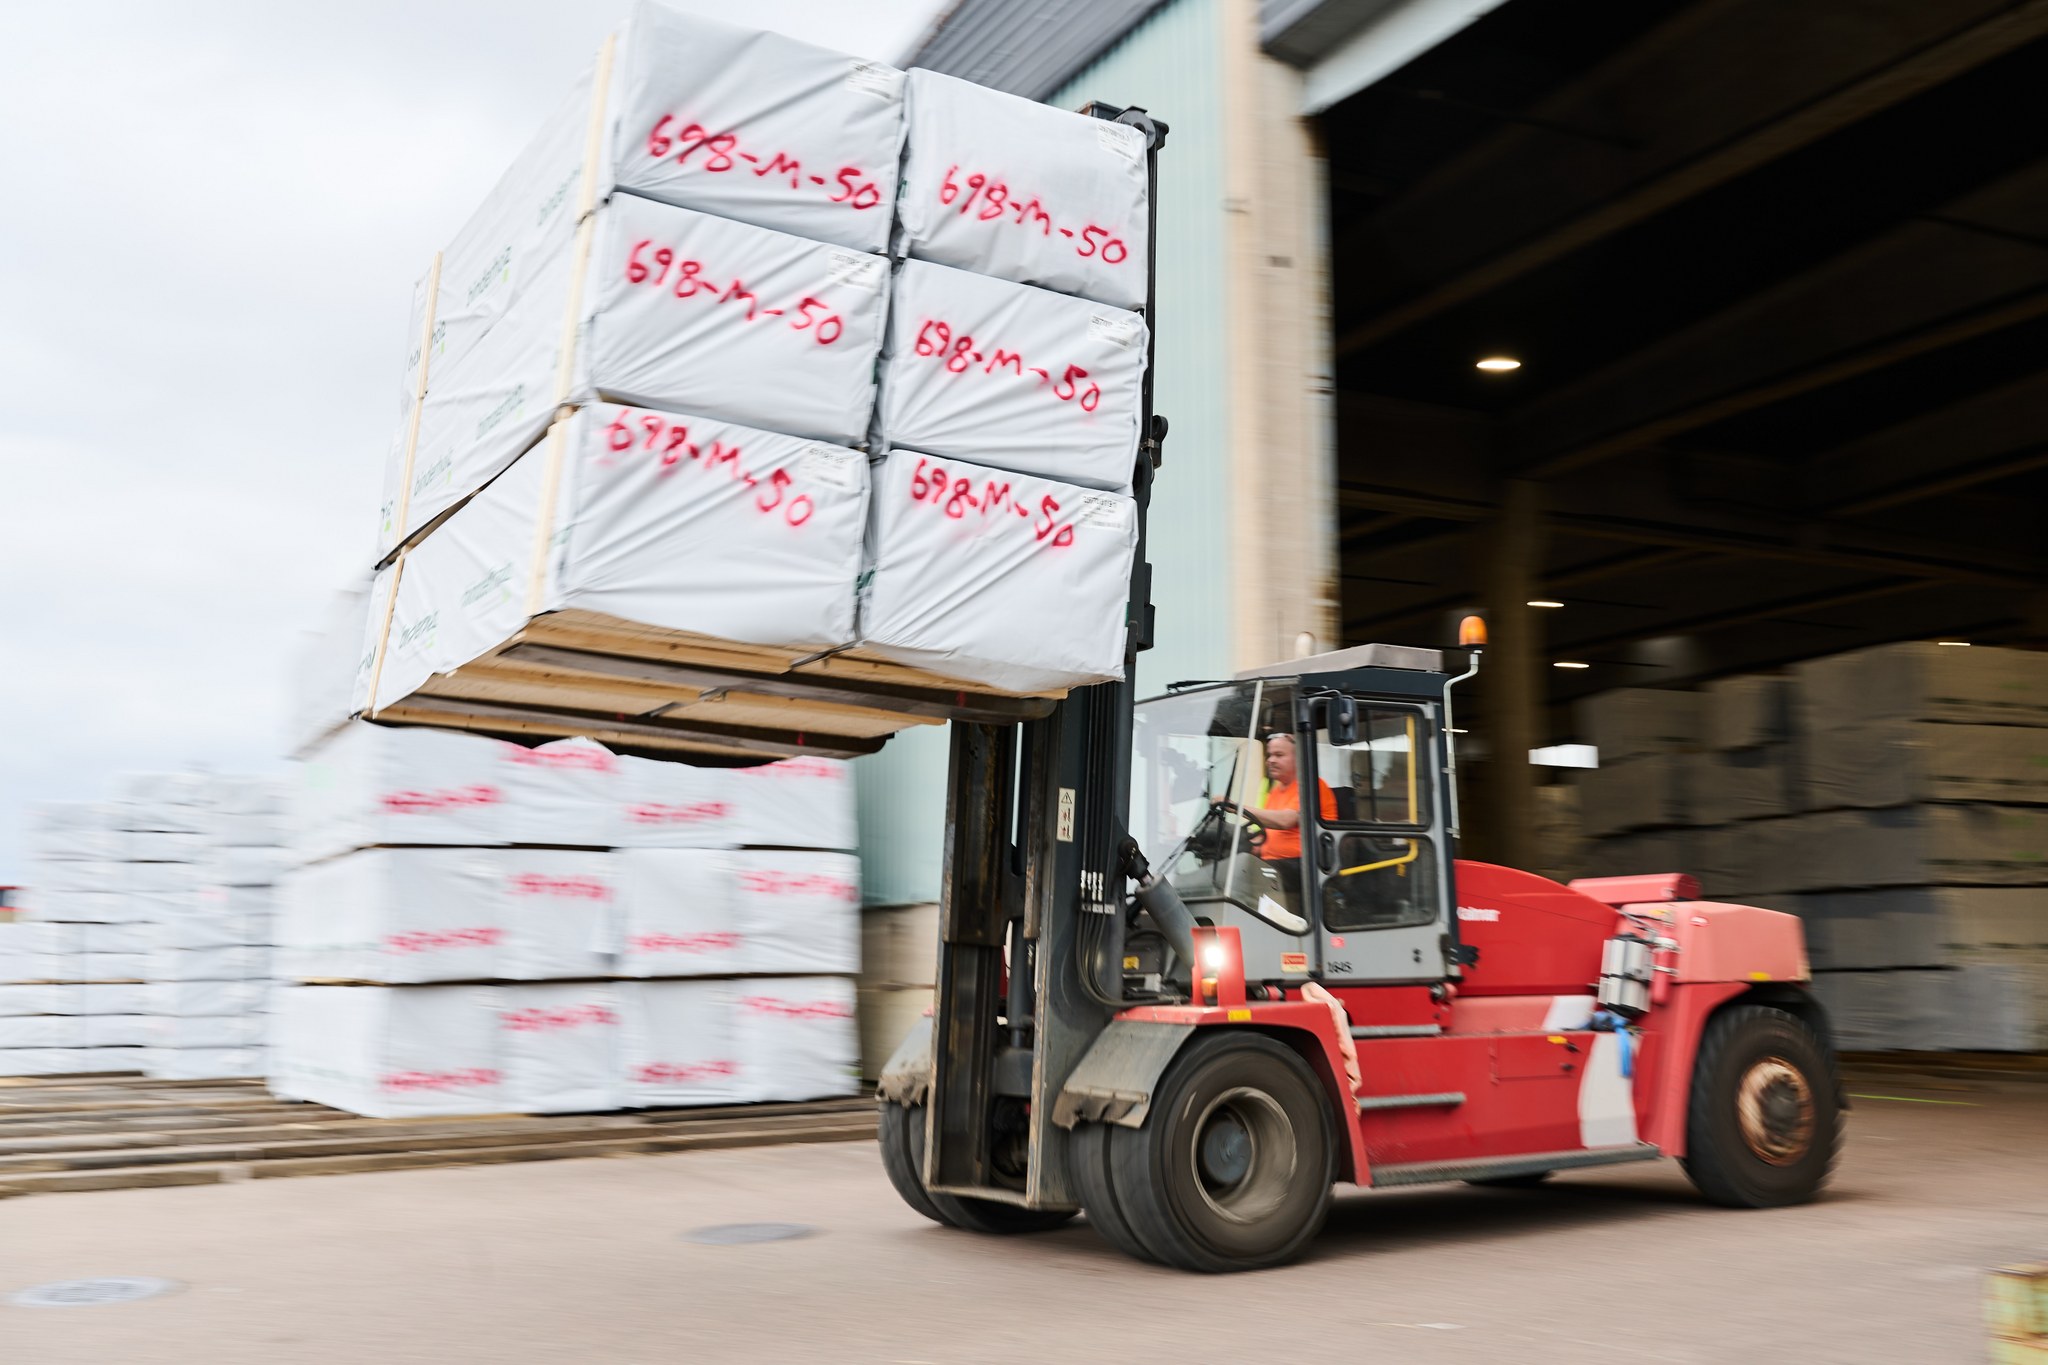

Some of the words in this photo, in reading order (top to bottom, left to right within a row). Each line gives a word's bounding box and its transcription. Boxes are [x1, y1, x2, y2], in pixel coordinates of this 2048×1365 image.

[647, 113, 881, 211] 698-M-50
[939, 164, 1128, 265] 698-M-50
[626, 238, 844, 346] 698-M-50
[914, 319, 1101, 413] 698-M-50
[604, 406, 813, 528] 698-M-50
[910, 457, 1075, 549] 698-M-50
